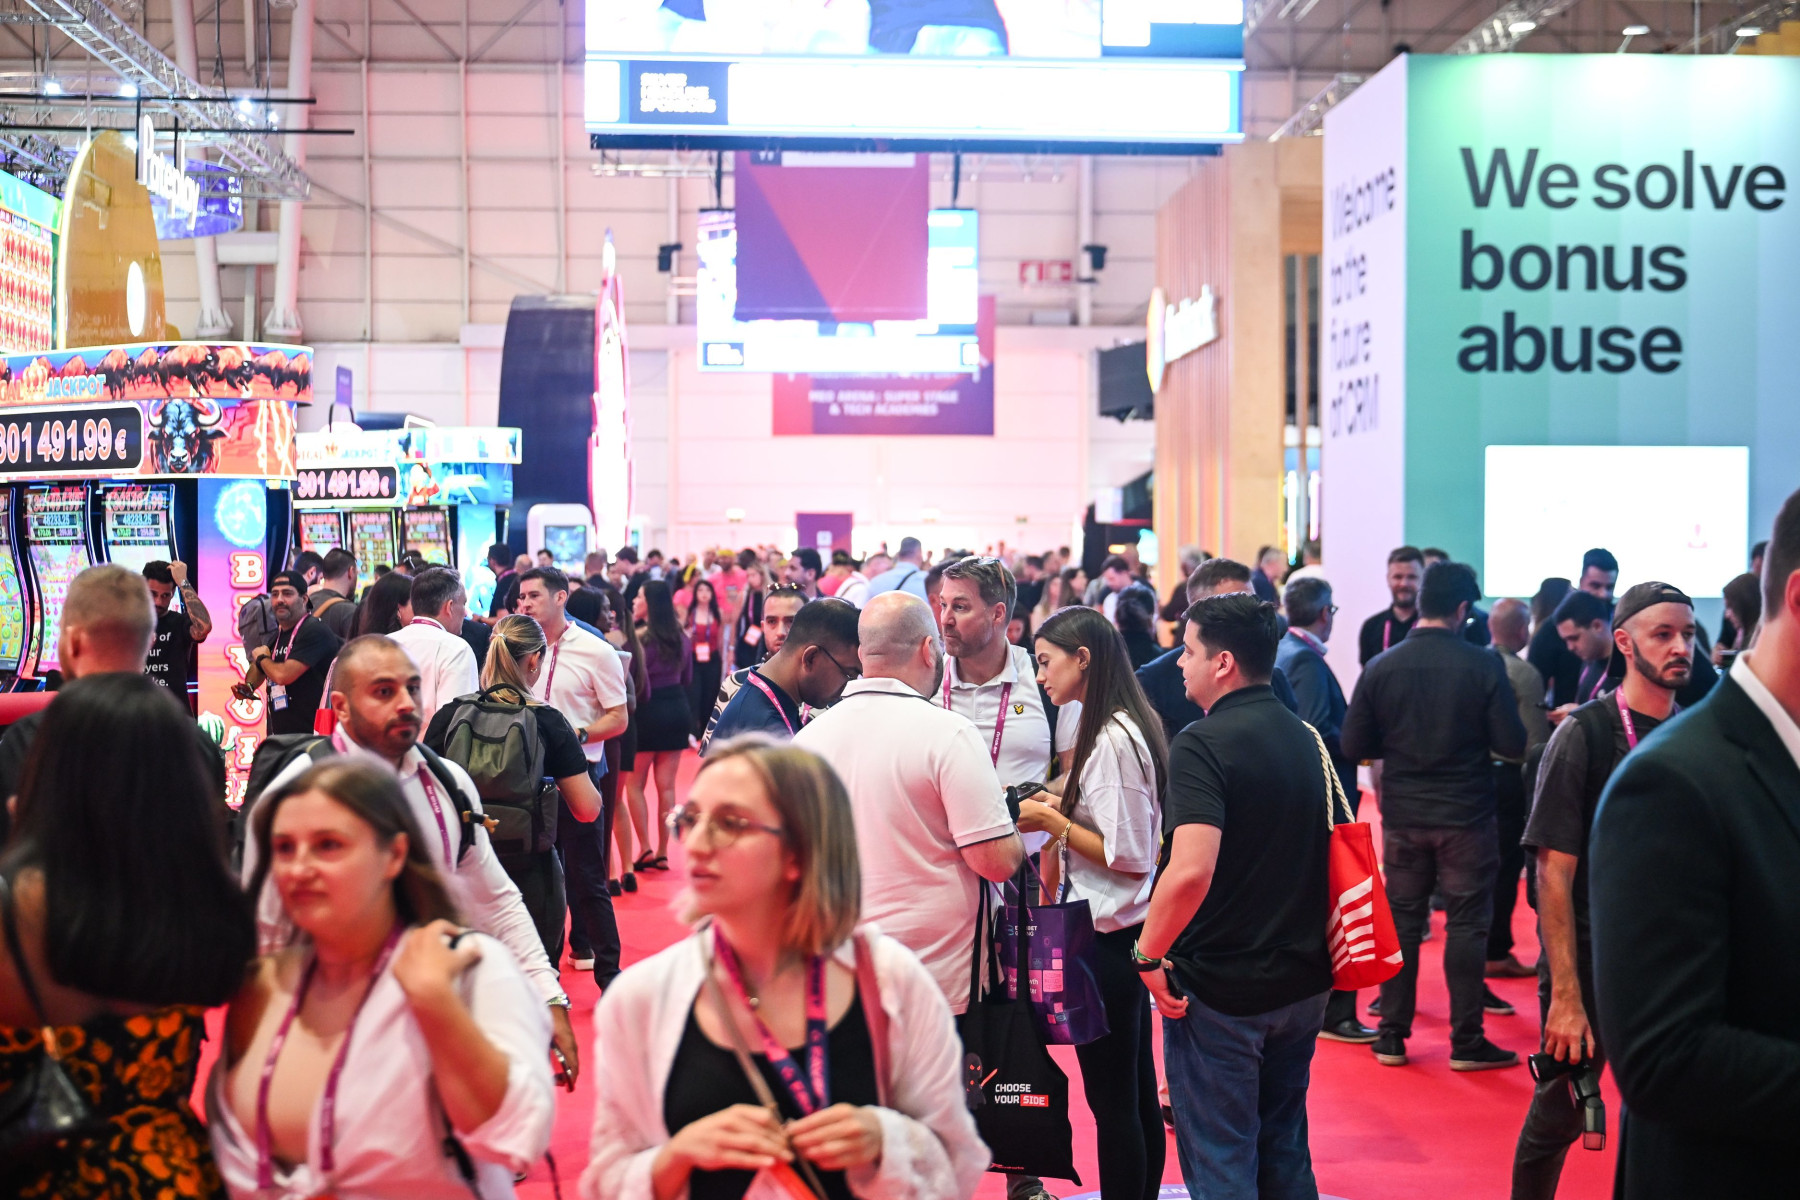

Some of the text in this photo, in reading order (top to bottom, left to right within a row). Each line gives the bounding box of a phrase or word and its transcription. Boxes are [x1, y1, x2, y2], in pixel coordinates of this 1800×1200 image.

[1459, 147, 1786, 211] We solve
[1331, 166, 1395, 238] Welcome
[1461, 228, 1687, 291] bonus
[1331, 250, 1366, 306] to the
[1457, 310, 1683, 374] abuse
[46, 373, 106, 398] JACKPOT
[36, 418, 112, 462] 491.99
[115, 428, 127, 460] €
[297, 470, 326, 498] 301
[159, 631, 171, 642] of
[149, 648, 161, 657] ur
[145, 664, 169, 675] yers
[994, 1095, 1046, 1106] YOUR SIDE
[995, 1083, 1031, 1093] CHOOSE
